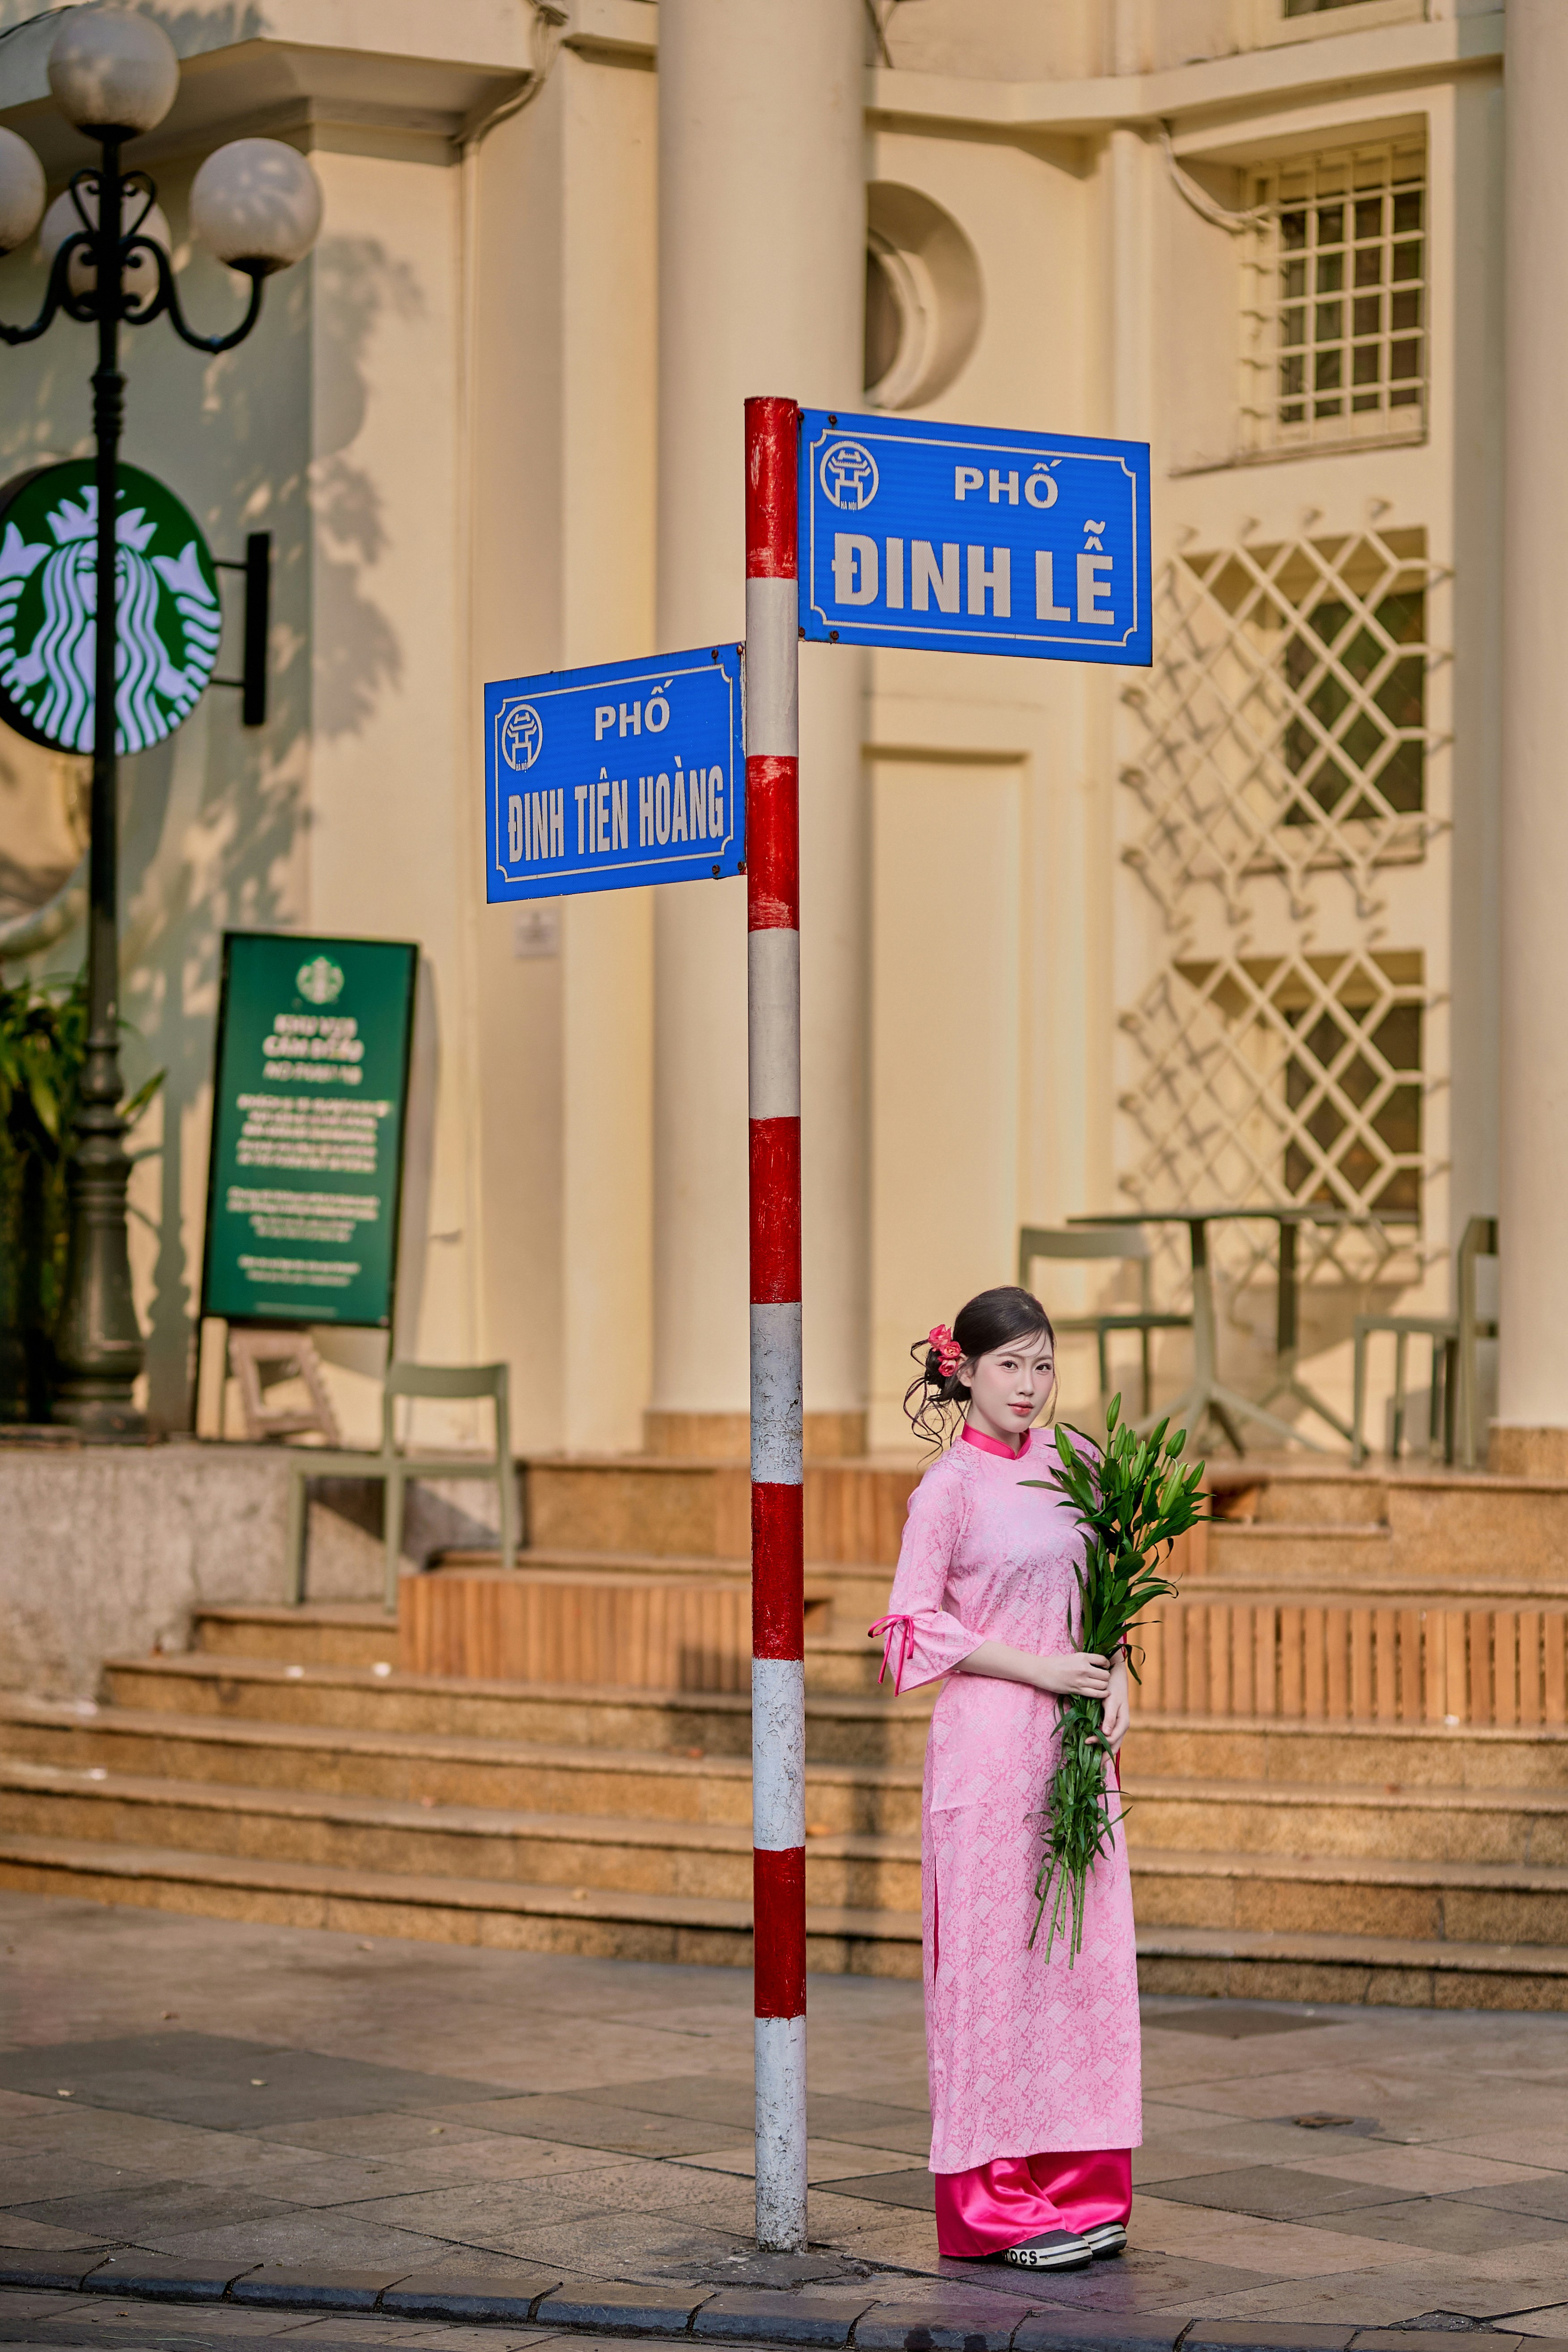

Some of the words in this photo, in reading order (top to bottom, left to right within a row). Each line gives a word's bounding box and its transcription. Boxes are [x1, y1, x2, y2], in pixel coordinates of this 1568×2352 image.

[954, 459, 1062, 509] PHỐ
[831, 532, 1011, 618] ĐINH
[1035, 519, 1115, 625] LỄ
[595, 679, 673, 741] PHỐ
[508, 788, 564, 863] ĐINH
[574, 767, 629, 855] TIÊN
[639, 755, 724, 847] HOÀNG
